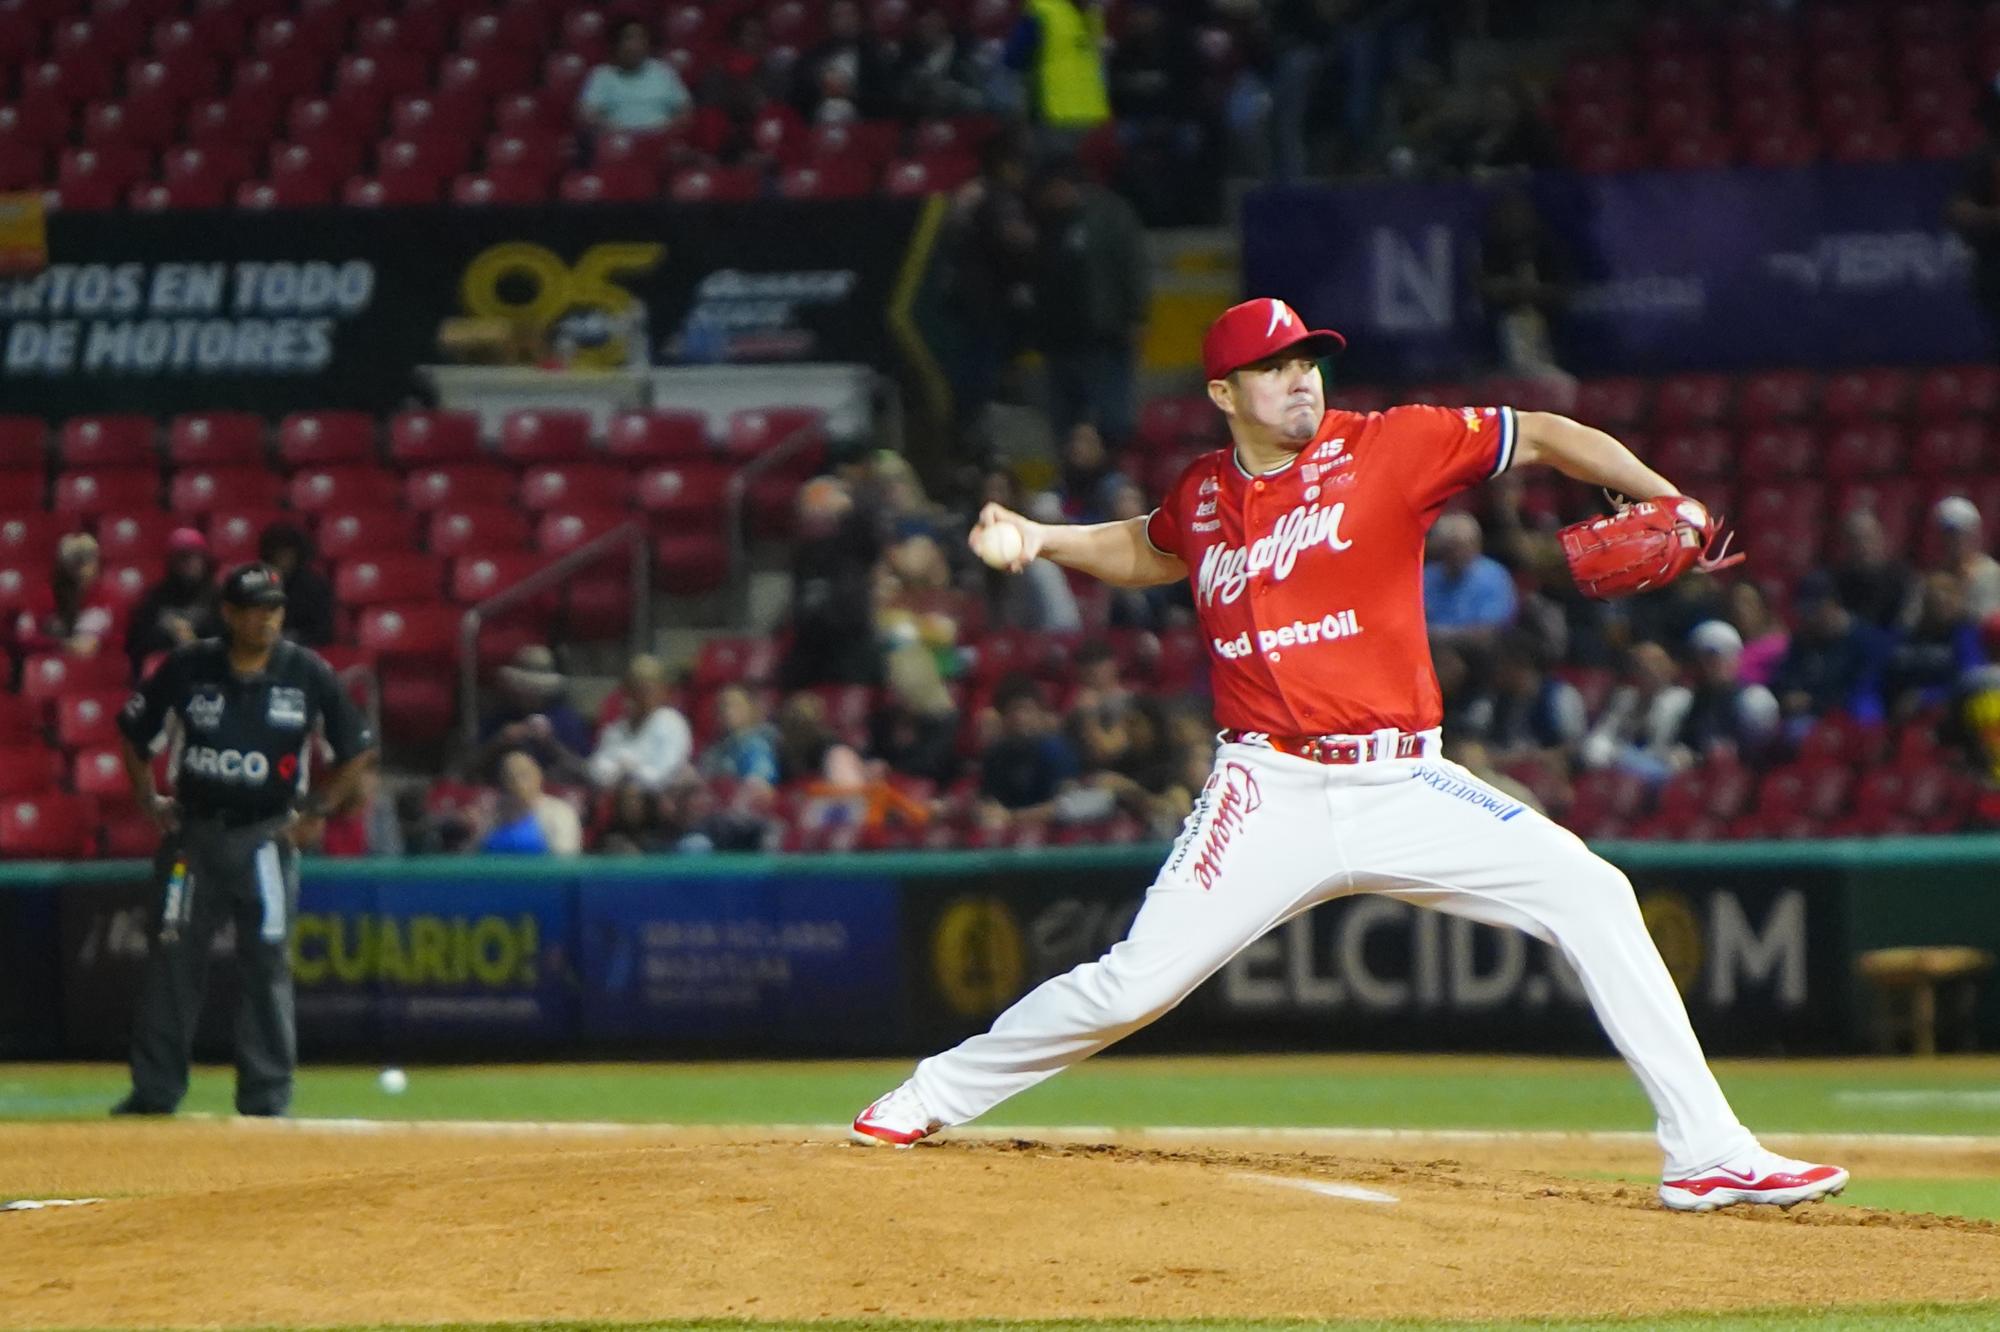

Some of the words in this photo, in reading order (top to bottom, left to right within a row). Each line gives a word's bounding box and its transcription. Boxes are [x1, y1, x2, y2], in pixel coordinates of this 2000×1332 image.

[149, 262, 226, 309] EN
[235, 261, 376, 308] TODO
[7, 320, 79, 369] DE
[85, 320, 333, 368] MOTORES
[1194, 762, 1262, 890] Caliente
